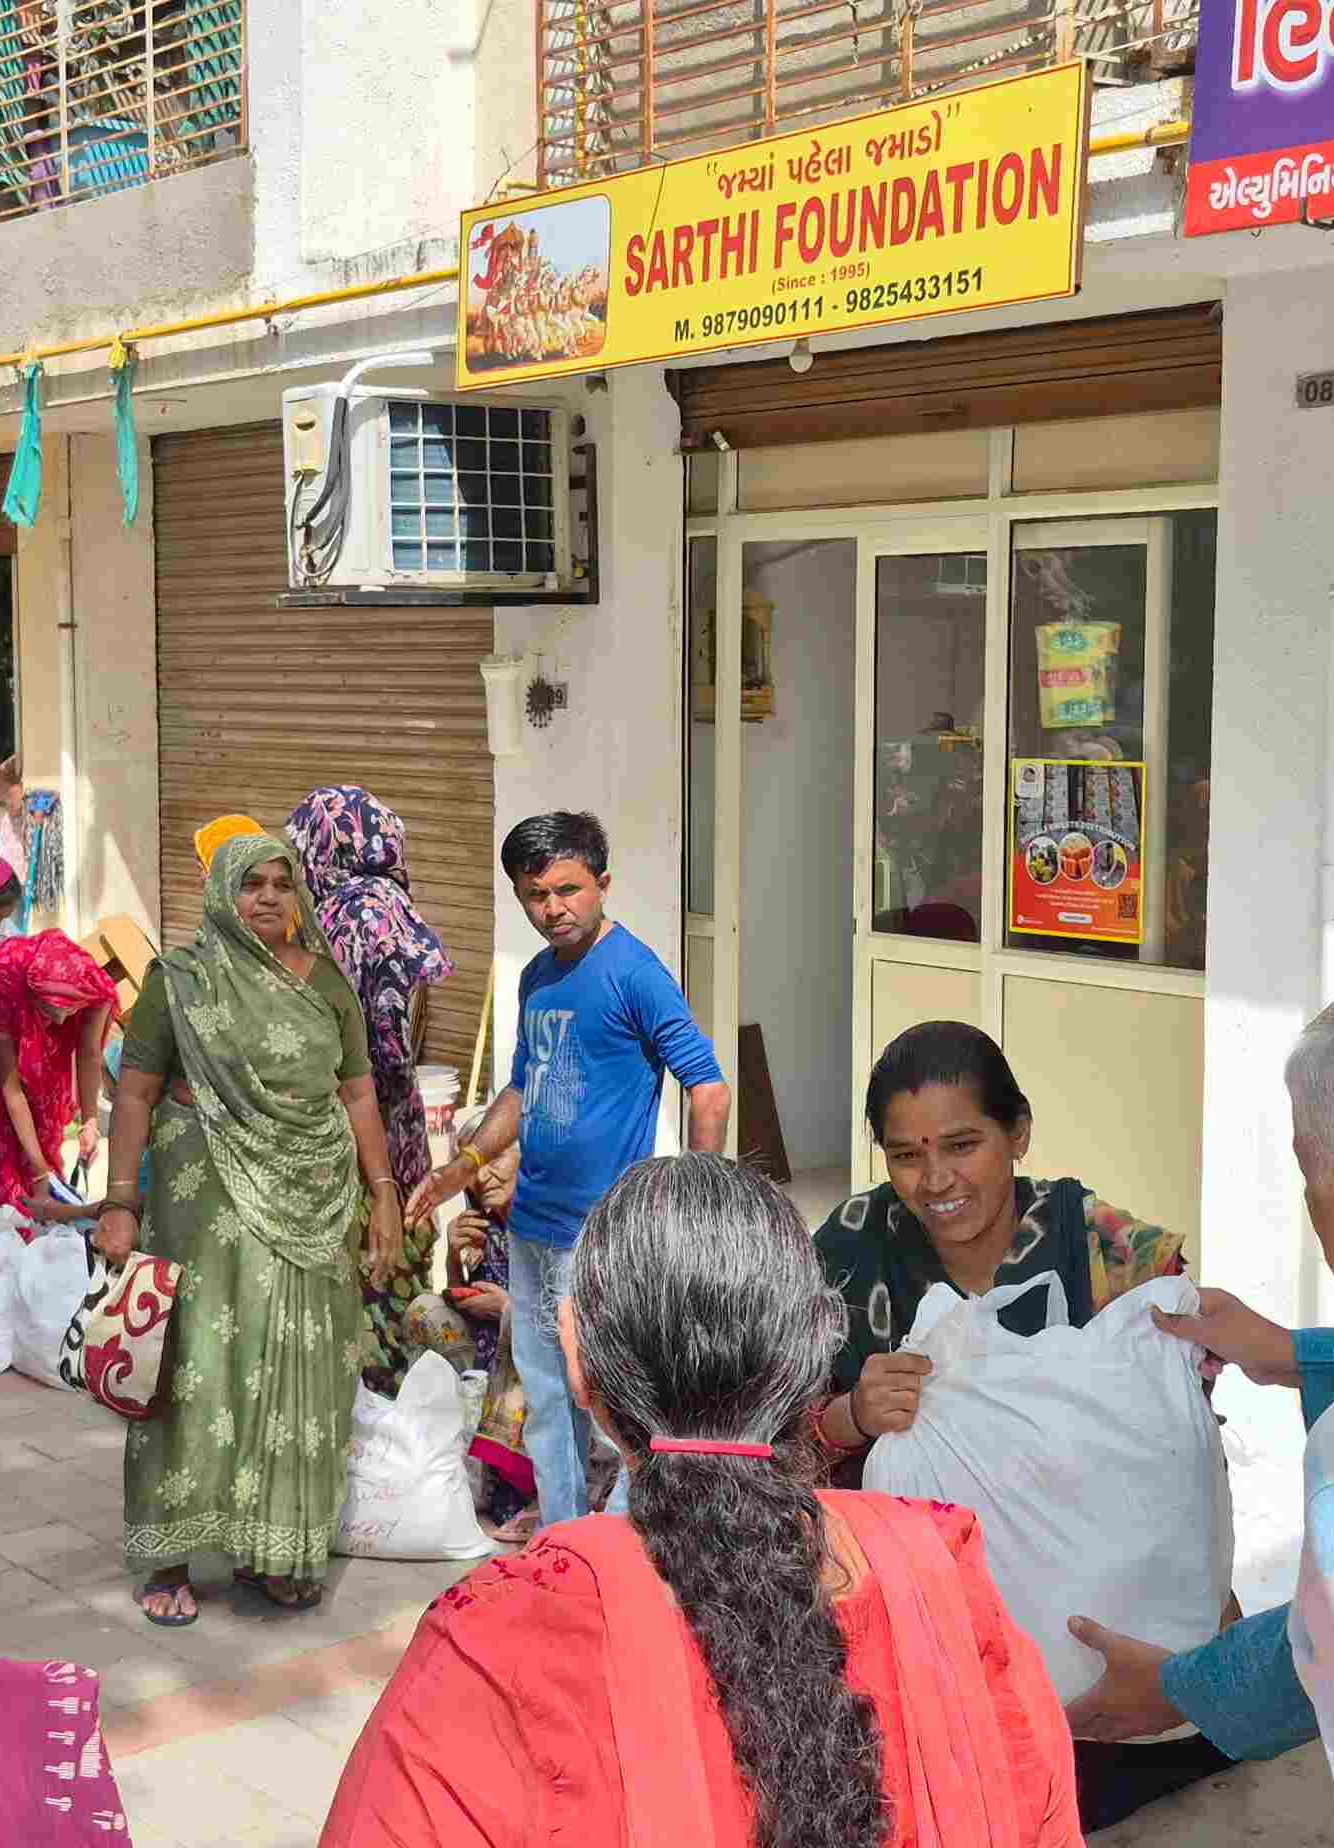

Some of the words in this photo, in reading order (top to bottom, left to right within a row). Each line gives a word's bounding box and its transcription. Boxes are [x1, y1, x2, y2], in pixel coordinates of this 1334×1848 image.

[788, 140, 851, 183] પહેલા
[624, 207, 760, 297] SARTHI
[772, 143, 1063, 269] FOUNDATION
[772, 273, 816, 295] (Since
[830, 262, 871, 282] 1995)
[674, 319, 695, 342] M.
[702, 296, 825, 337] 9879090111
[846, 267, 984, 313] 9825433151
[1305, 379, 1333, 402] 08
